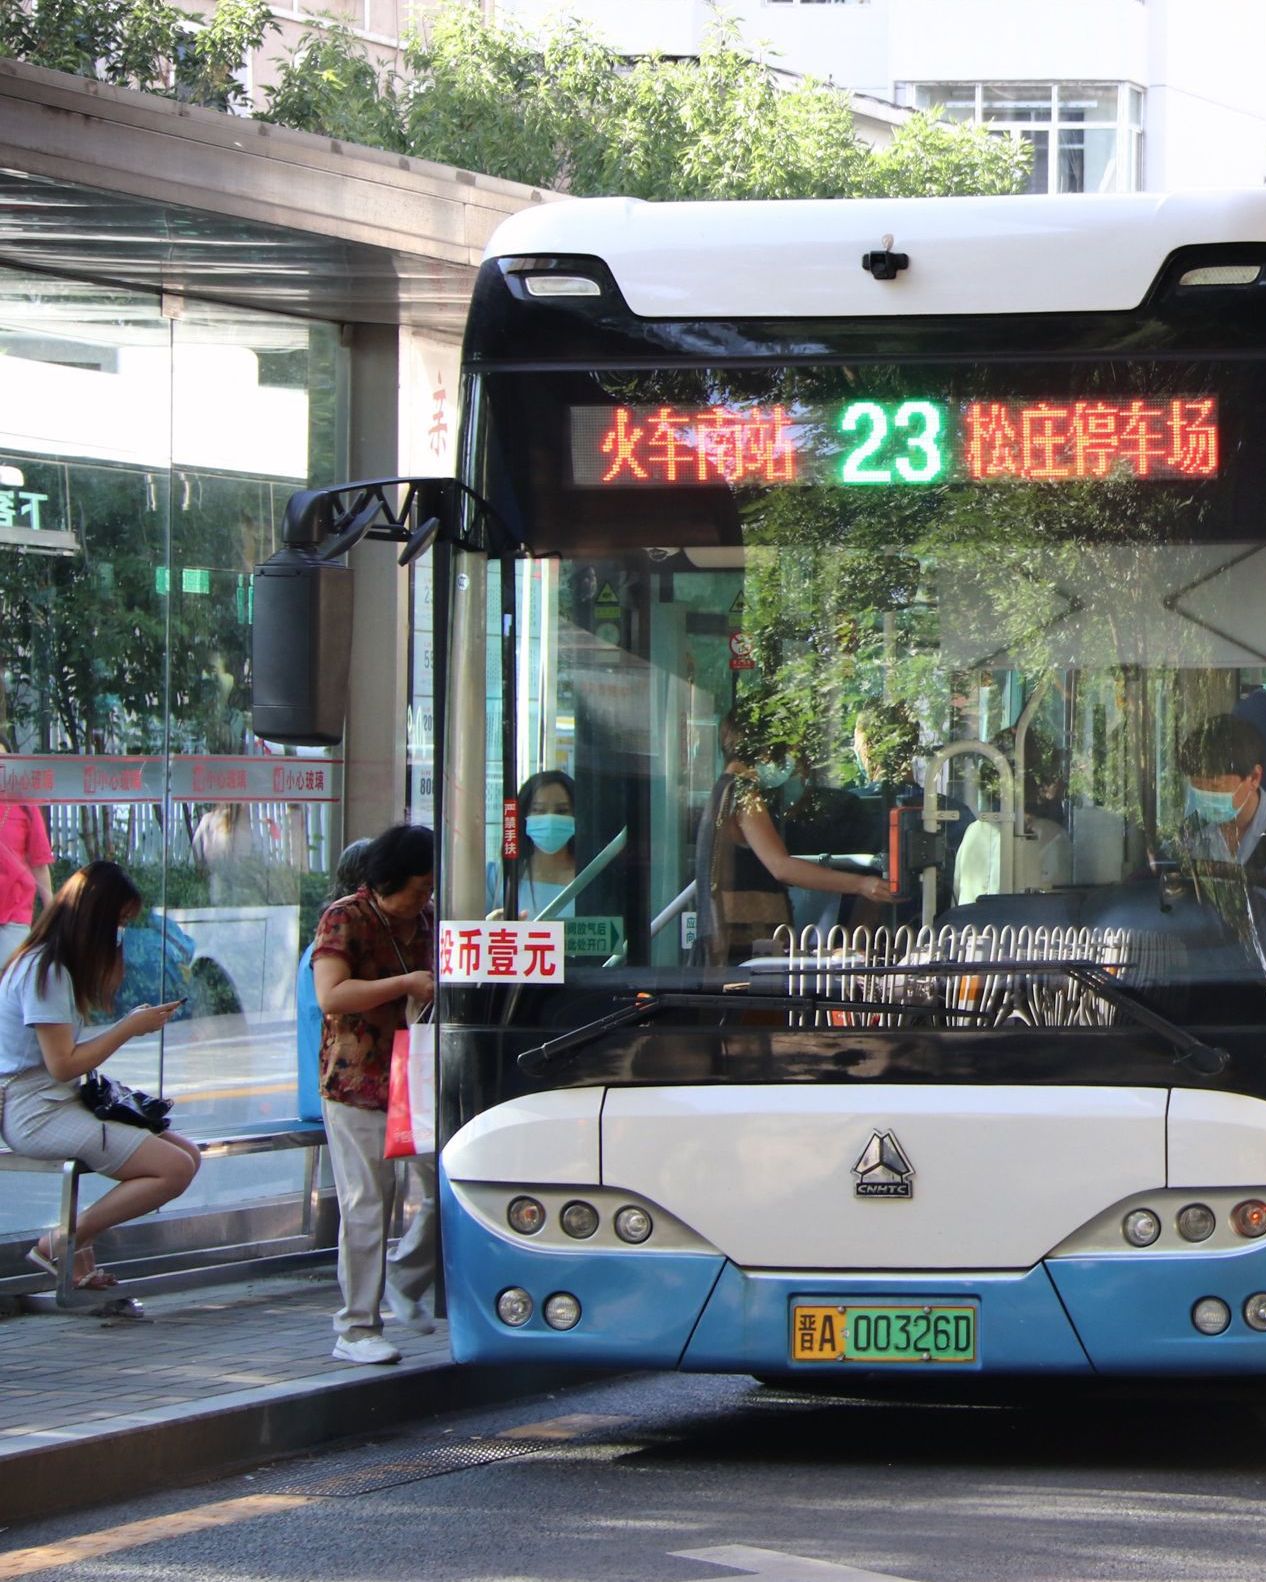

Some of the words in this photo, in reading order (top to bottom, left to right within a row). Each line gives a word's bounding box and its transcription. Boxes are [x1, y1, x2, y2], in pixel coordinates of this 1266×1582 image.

[602, 406, 794, 481] 火车南站
[841, 401, 942, 484] 23
[966, 400, 1220, 479] 松庄停车场
[286, 770, 324, 792] 小心玻璃
[503, 802, 517, 856] 严禁手扶
[440, 928, 556, 977] 投币壹元
[857, 1183, 908, 1194] CNHTC
[798, 1314, 836, 1352] 晋A
[853, 1314, 971, 1352] 00326D
